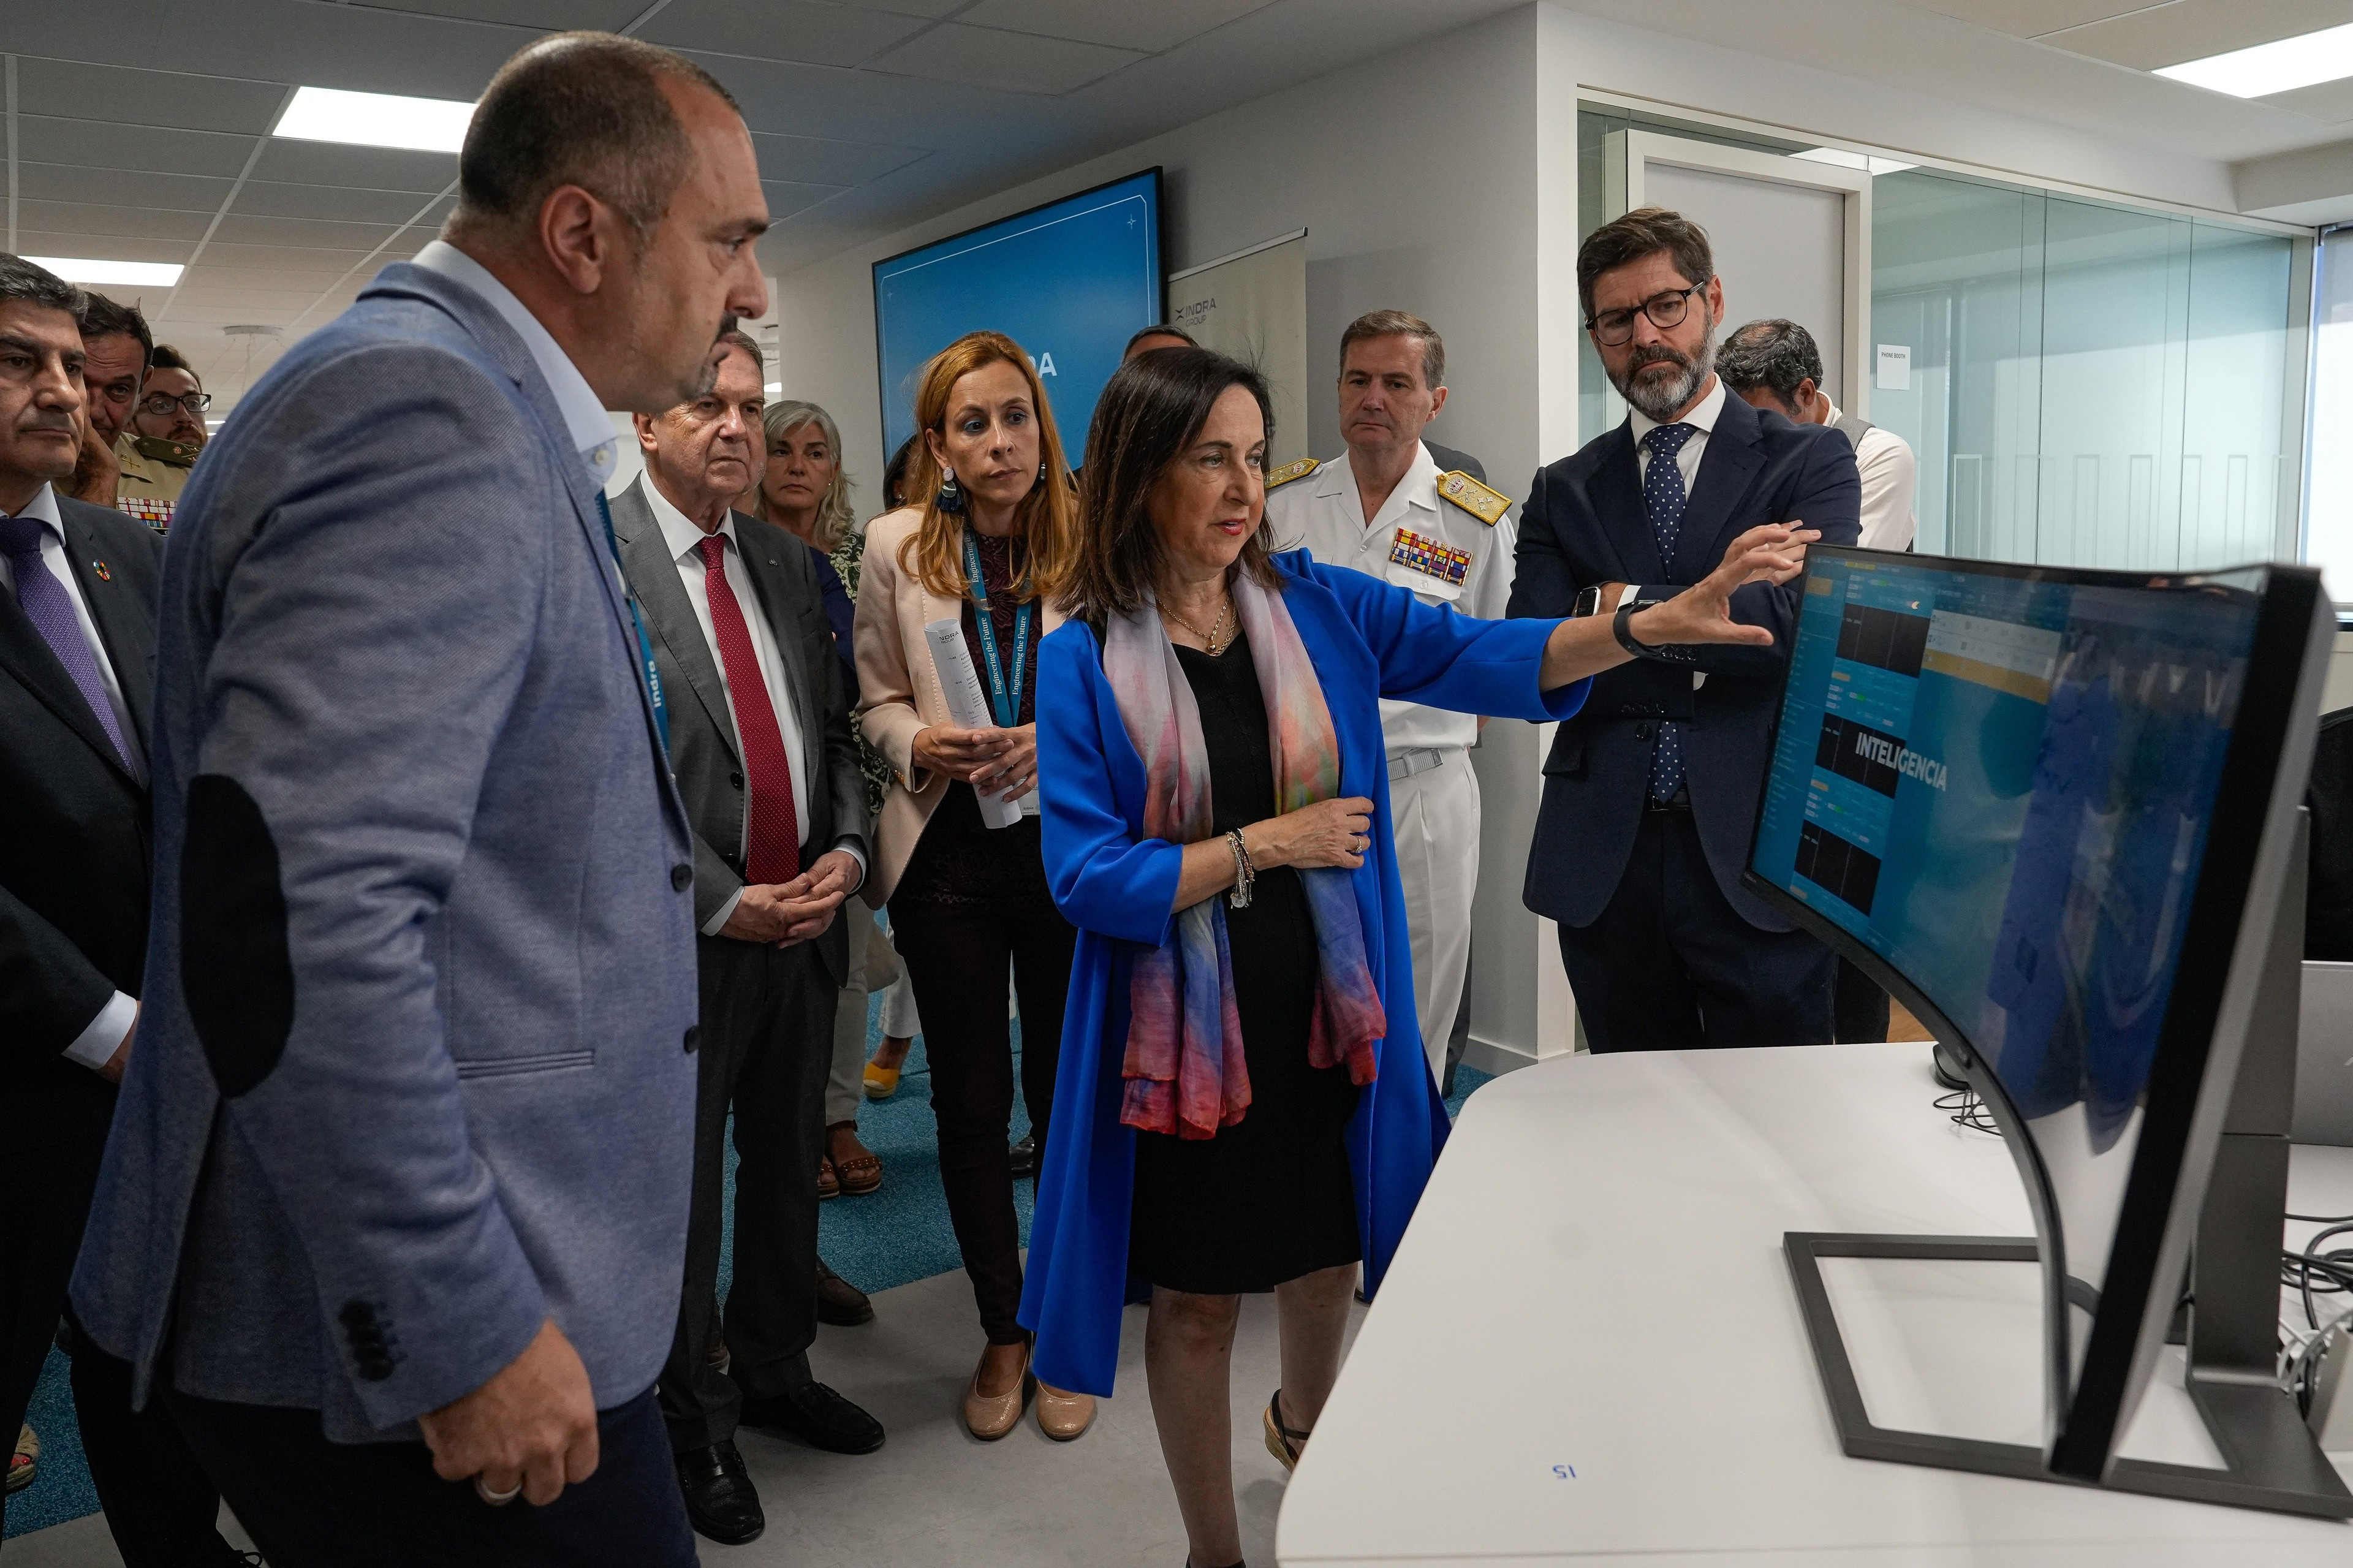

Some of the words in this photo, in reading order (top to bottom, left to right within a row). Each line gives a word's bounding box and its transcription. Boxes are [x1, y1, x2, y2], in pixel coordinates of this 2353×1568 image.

[1186, 298, 1216, 317] INDRA
[1186, 314, 1207, 327] GROUP
[966, 542, 979, 583] Engineering
[939, 631, 959, 641] NDRA
[981, 617, 991, 640] Future
[1012, 653, 1024, 695] Engineering
[1018, 616, 1027, 639] Future
[988, 653, 1002, 695] Engineering
[1855, 732, 1948, 792] INTELIGENCIA
